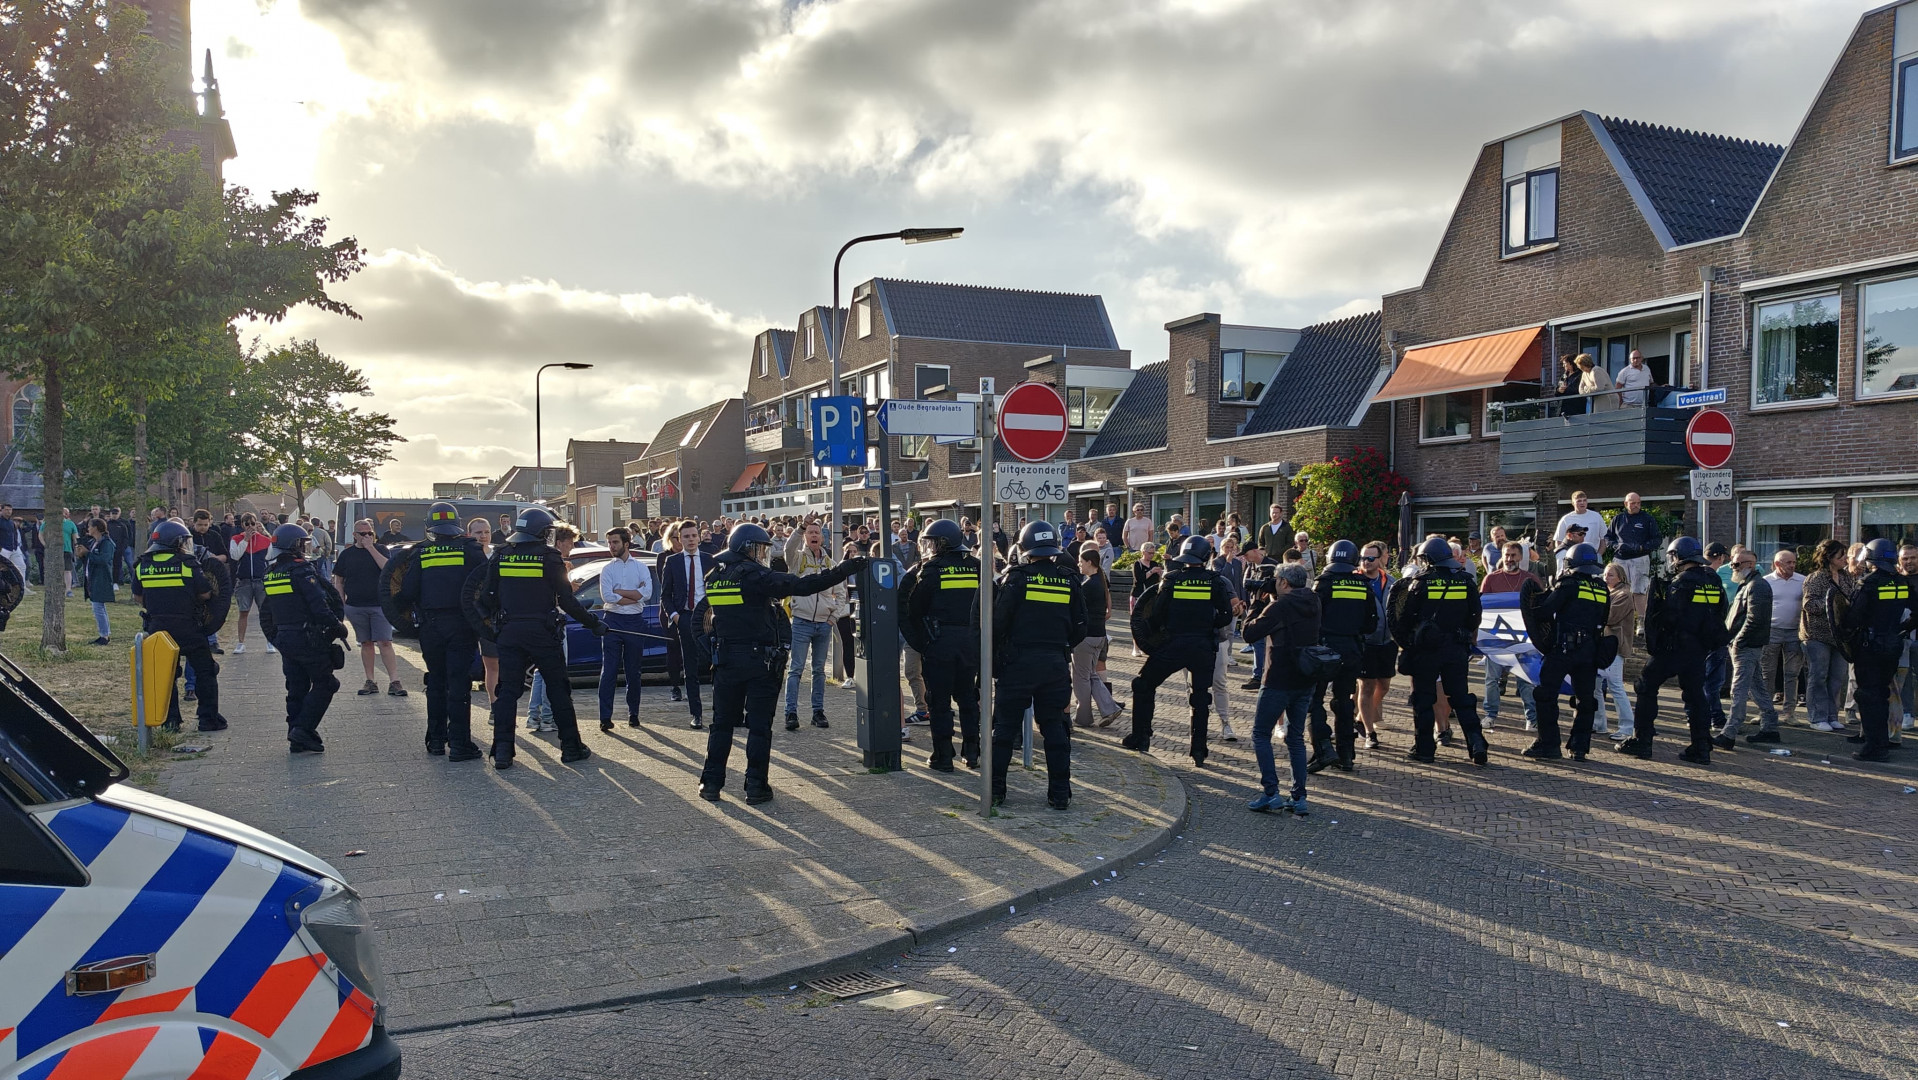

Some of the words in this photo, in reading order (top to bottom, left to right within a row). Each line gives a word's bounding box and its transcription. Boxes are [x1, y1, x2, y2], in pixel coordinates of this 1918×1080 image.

[1680, 393, 1723, 405] Voorstraat
[897, 403, 915, 411] Oude
[916, 403, 962, 412] Begraafplaats
[820, 405, 840, 441] P
[850, 405, 861, 440] P
[1000, 464, 1067, 477] uitgezonderd
[1693, 471, 1732, 480] uitgezonderd
[878, 563, 891, 584] P
[1032, 573, 1066, 585] POLITIE
